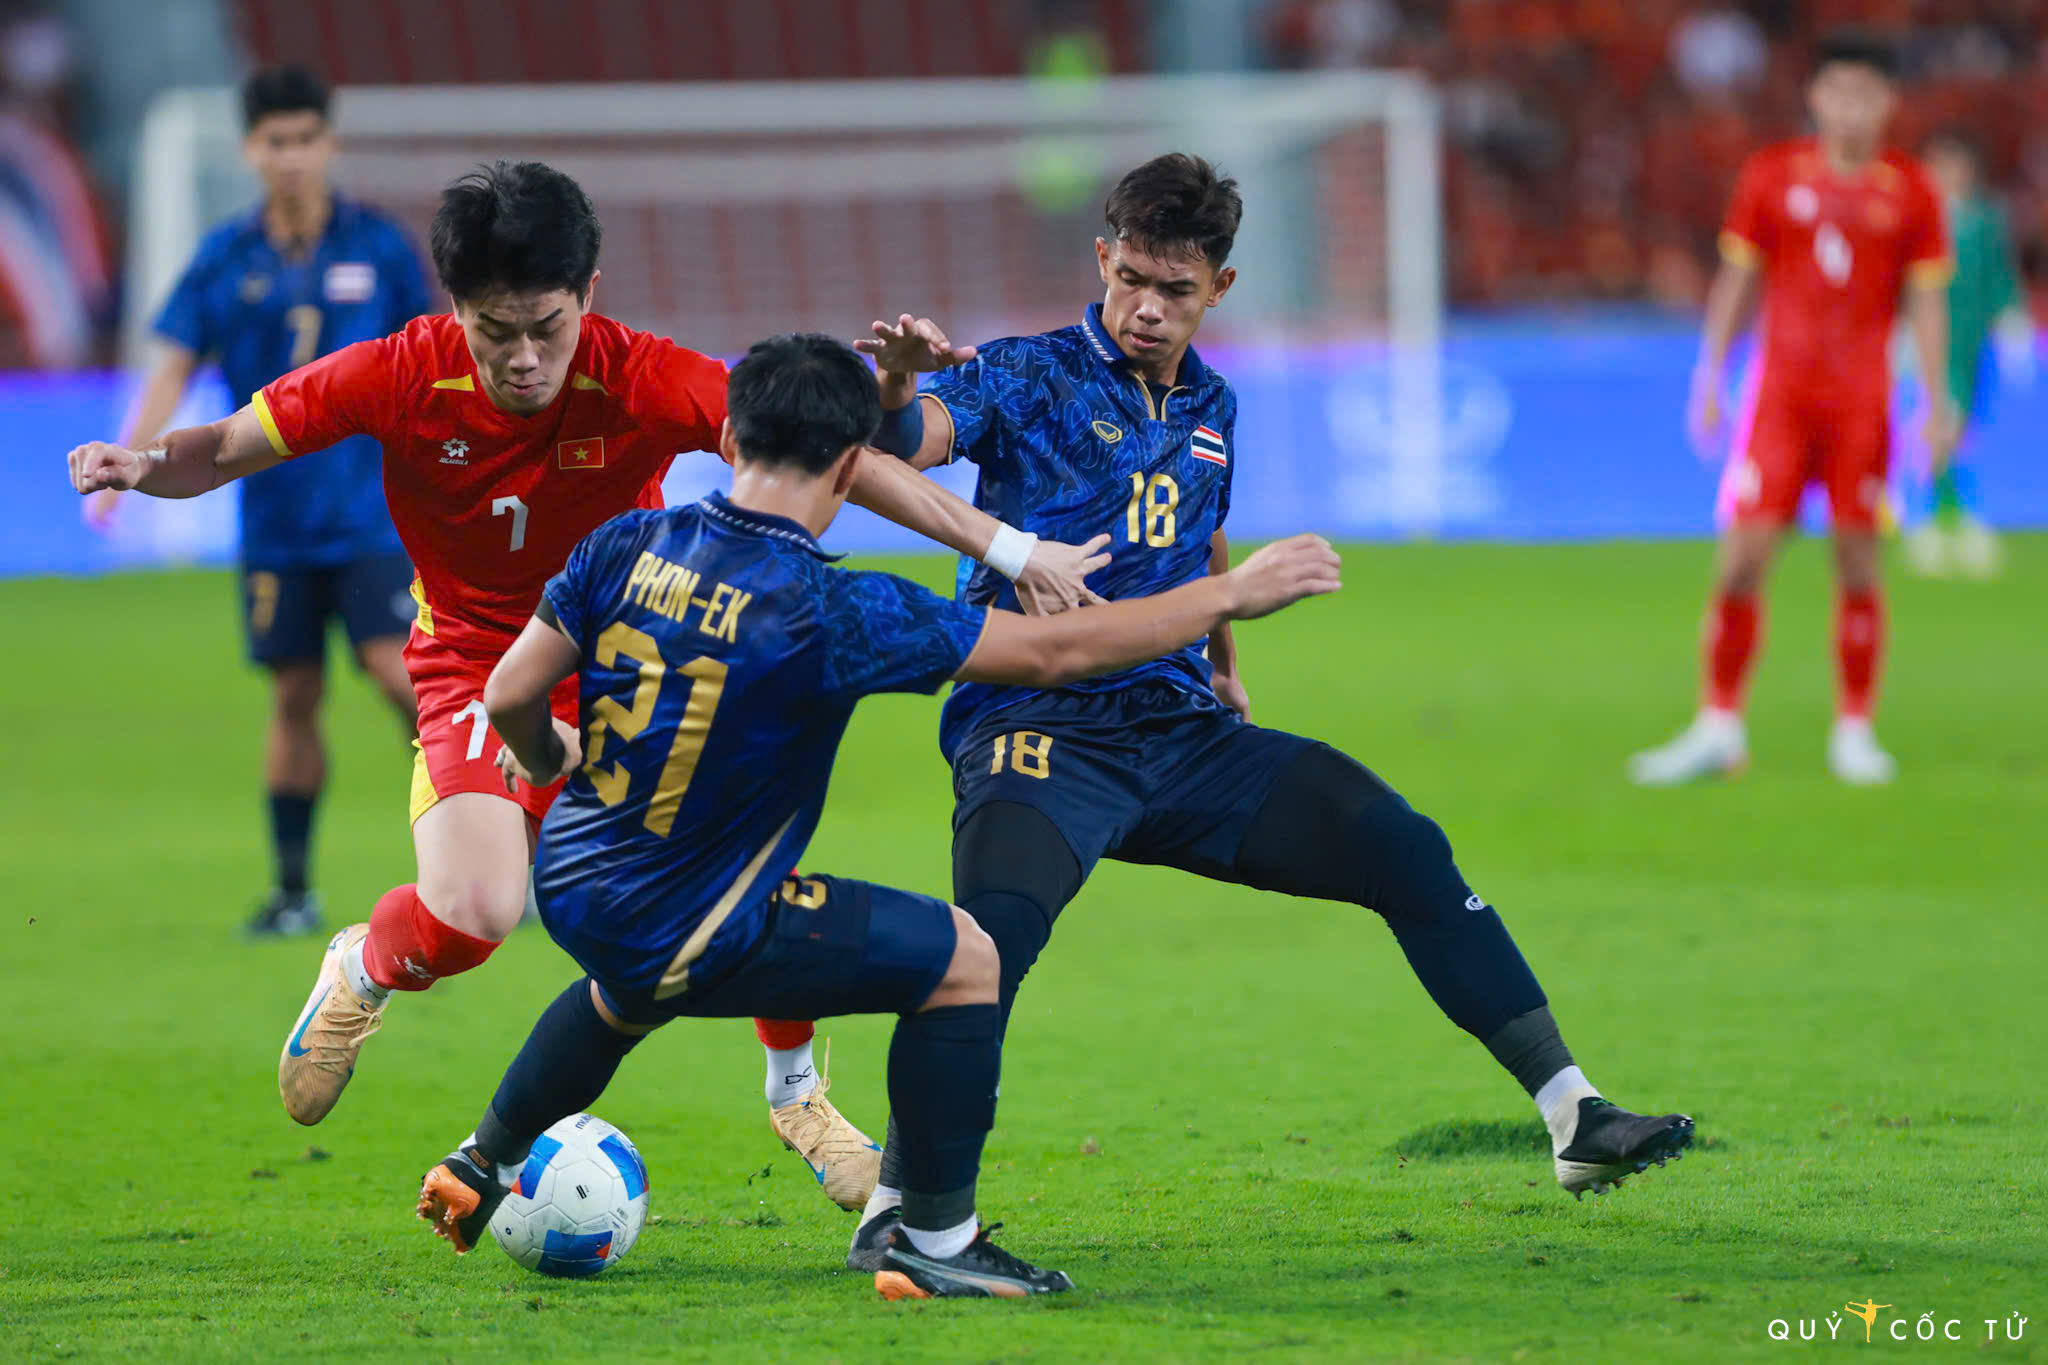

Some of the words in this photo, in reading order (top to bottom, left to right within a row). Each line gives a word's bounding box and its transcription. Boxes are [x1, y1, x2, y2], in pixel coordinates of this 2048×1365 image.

[492, 495, 528, 552] 7
[1127, 471, 1179, 547] 18
[623, 551, 752, 643] PHON-EK
[583, 621, 729, 839] 21
[990, 731, 1053, 779] 18
